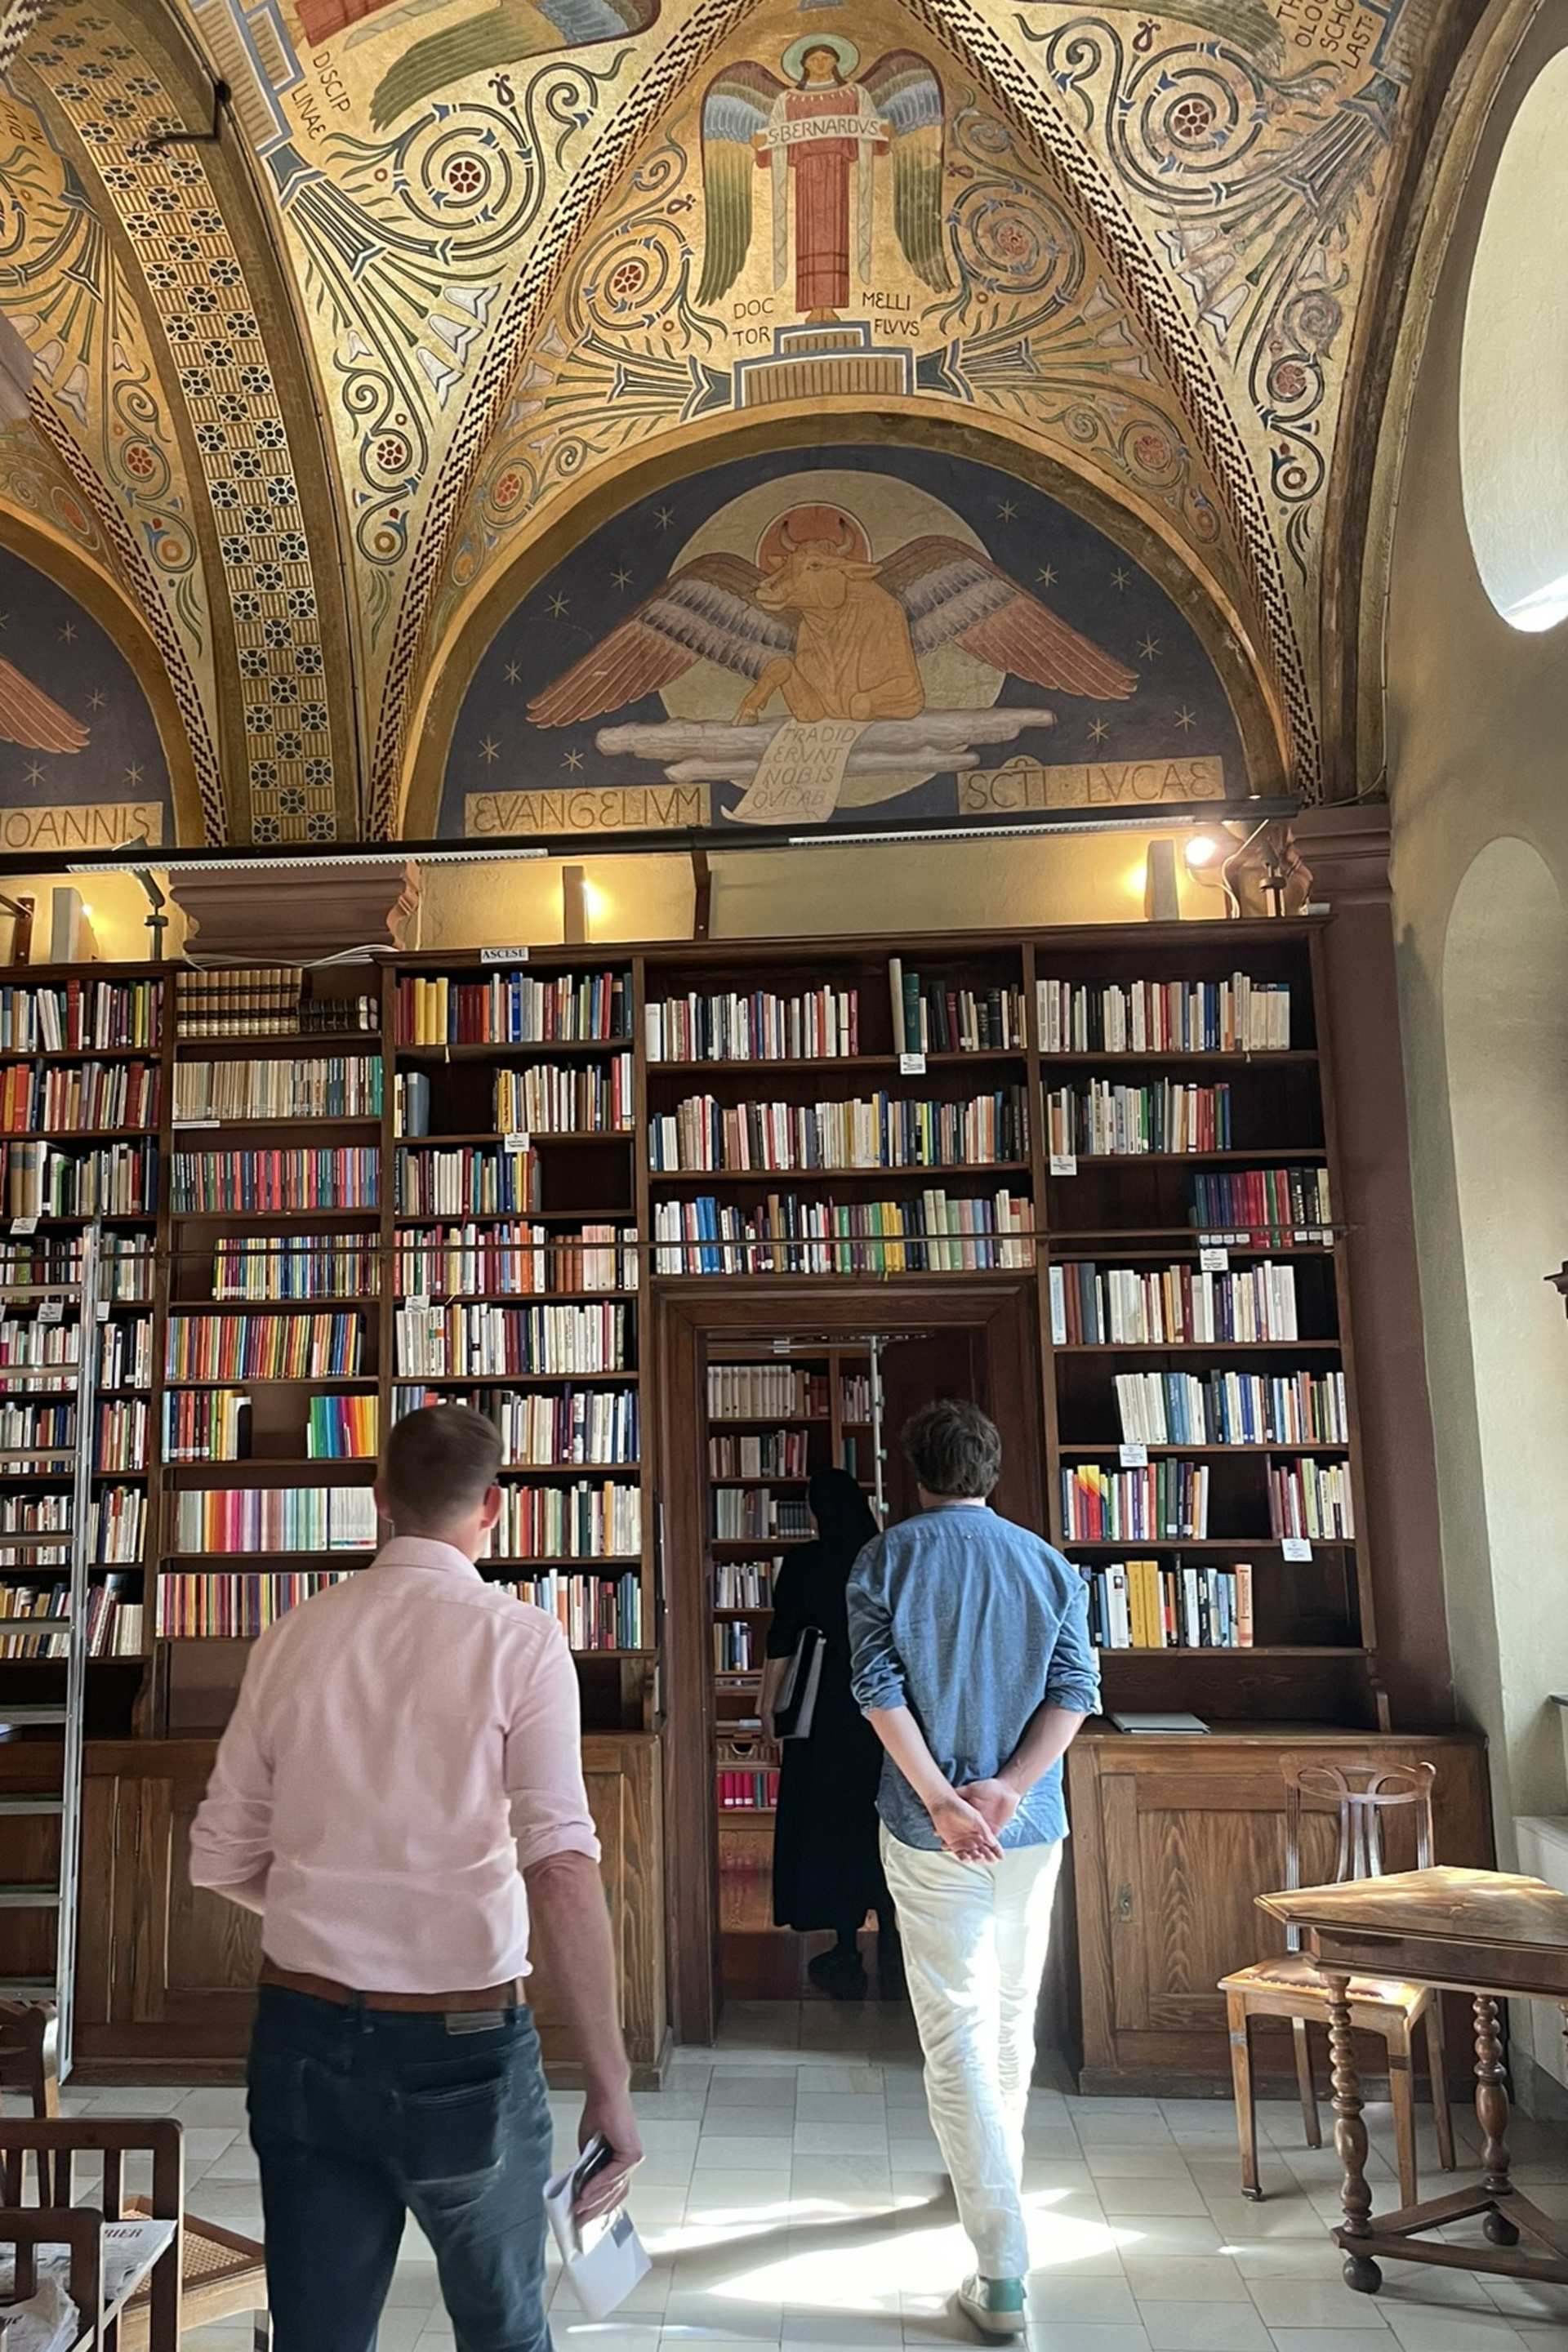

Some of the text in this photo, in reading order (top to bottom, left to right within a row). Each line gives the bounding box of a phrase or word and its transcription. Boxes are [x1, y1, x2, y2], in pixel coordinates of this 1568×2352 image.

[1295, 0, 1329, 47] OLO
[312, 51, 351, 113] DISCIP
[291, 83, 327, 140] LINAE
[734, 297, 774, 318] DOC
[862, 292, 911, 311] MELLI
[733, 327, 770, 346] TOR
[874, 318, 920, 336] FLVVS
[1086, 762, 1216, 804] LVCAE
[0, 807, 150, 848] OANNIS
[474, 787, 702, 832] EVANGELIVM
[483, 948, 527, 959] ASCESE
